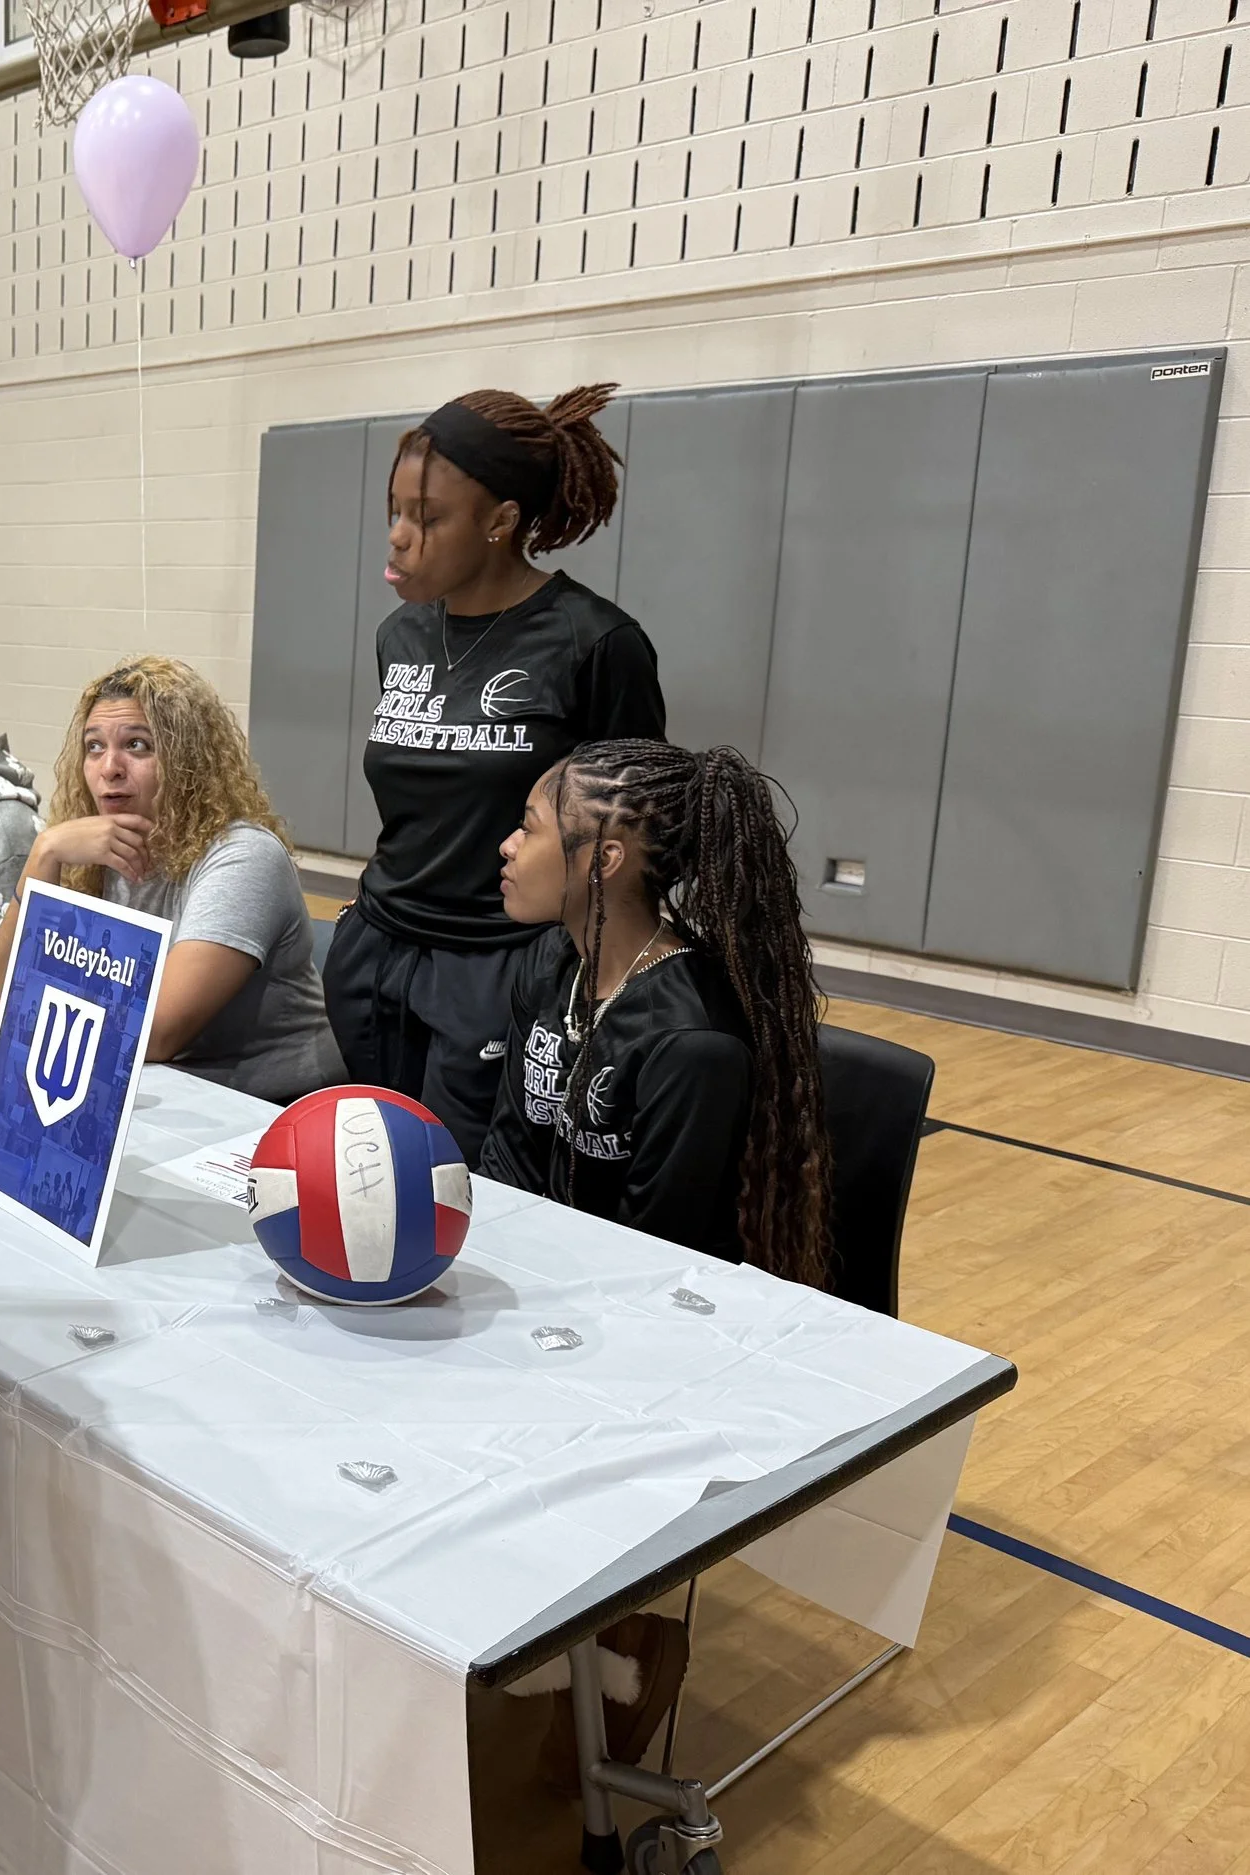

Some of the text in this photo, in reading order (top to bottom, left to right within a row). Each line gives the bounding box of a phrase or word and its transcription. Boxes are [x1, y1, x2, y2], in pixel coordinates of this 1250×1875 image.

[383, 664, 435, 692] UCA
[43, 928, 136, 988] Volleyball
[525, 1021, 562, 1067] CA
